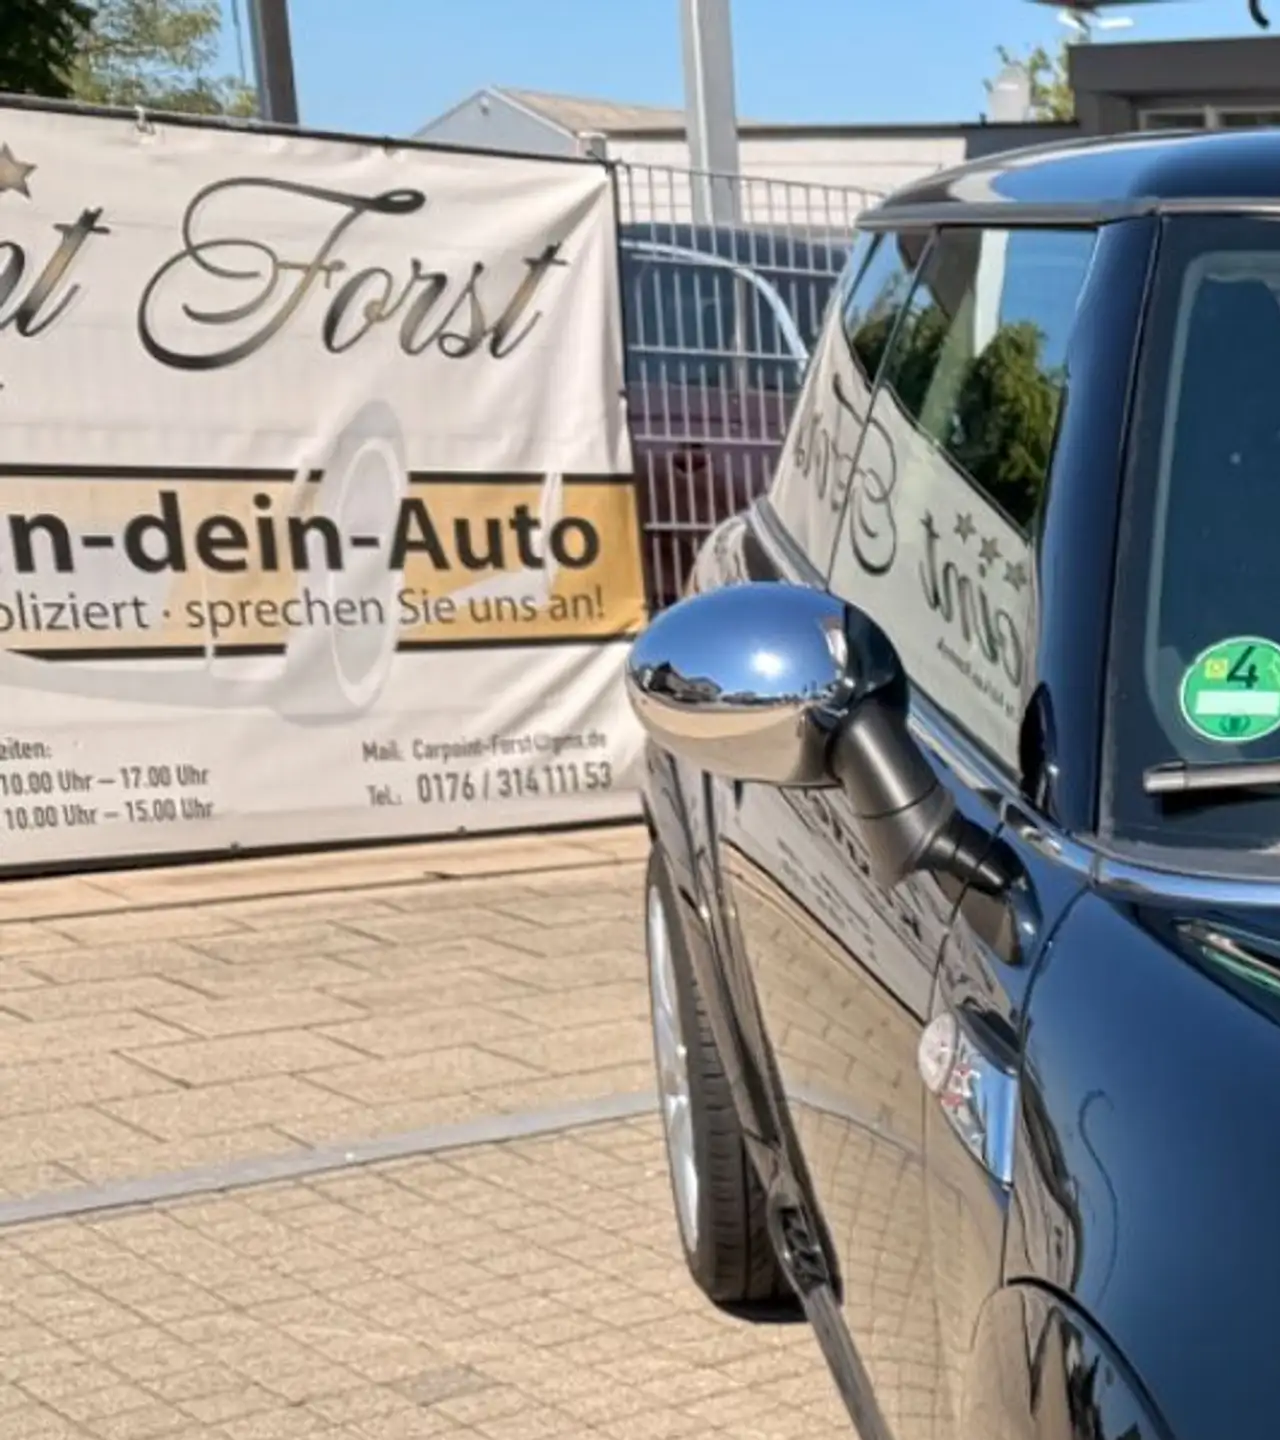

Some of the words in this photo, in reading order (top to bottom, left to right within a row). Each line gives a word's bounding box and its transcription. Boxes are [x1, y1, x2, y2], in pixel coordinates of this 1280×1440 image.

[138, 176, 569, 371] Forst
[186, 587, 384, 638] sprechen
[398, 587, 457, 625] Sie
[469, 591, 538, 623] uns
[549, 585, 606, 621] an!
[1226, 645, 1259, 690] 4
[57, 769, 93, 793] Uhr
[120, 765, 172, 789] 17.00
[176, 764, 209, 787] Uhr
[416, 771, 476, 803] 0176
[4, 805, 59, 830] 10.00
[62, 803, 98, 827] Uhr
[125, 799, 177, 823] 15.00
[180, 797, 215, 820] Uhr
